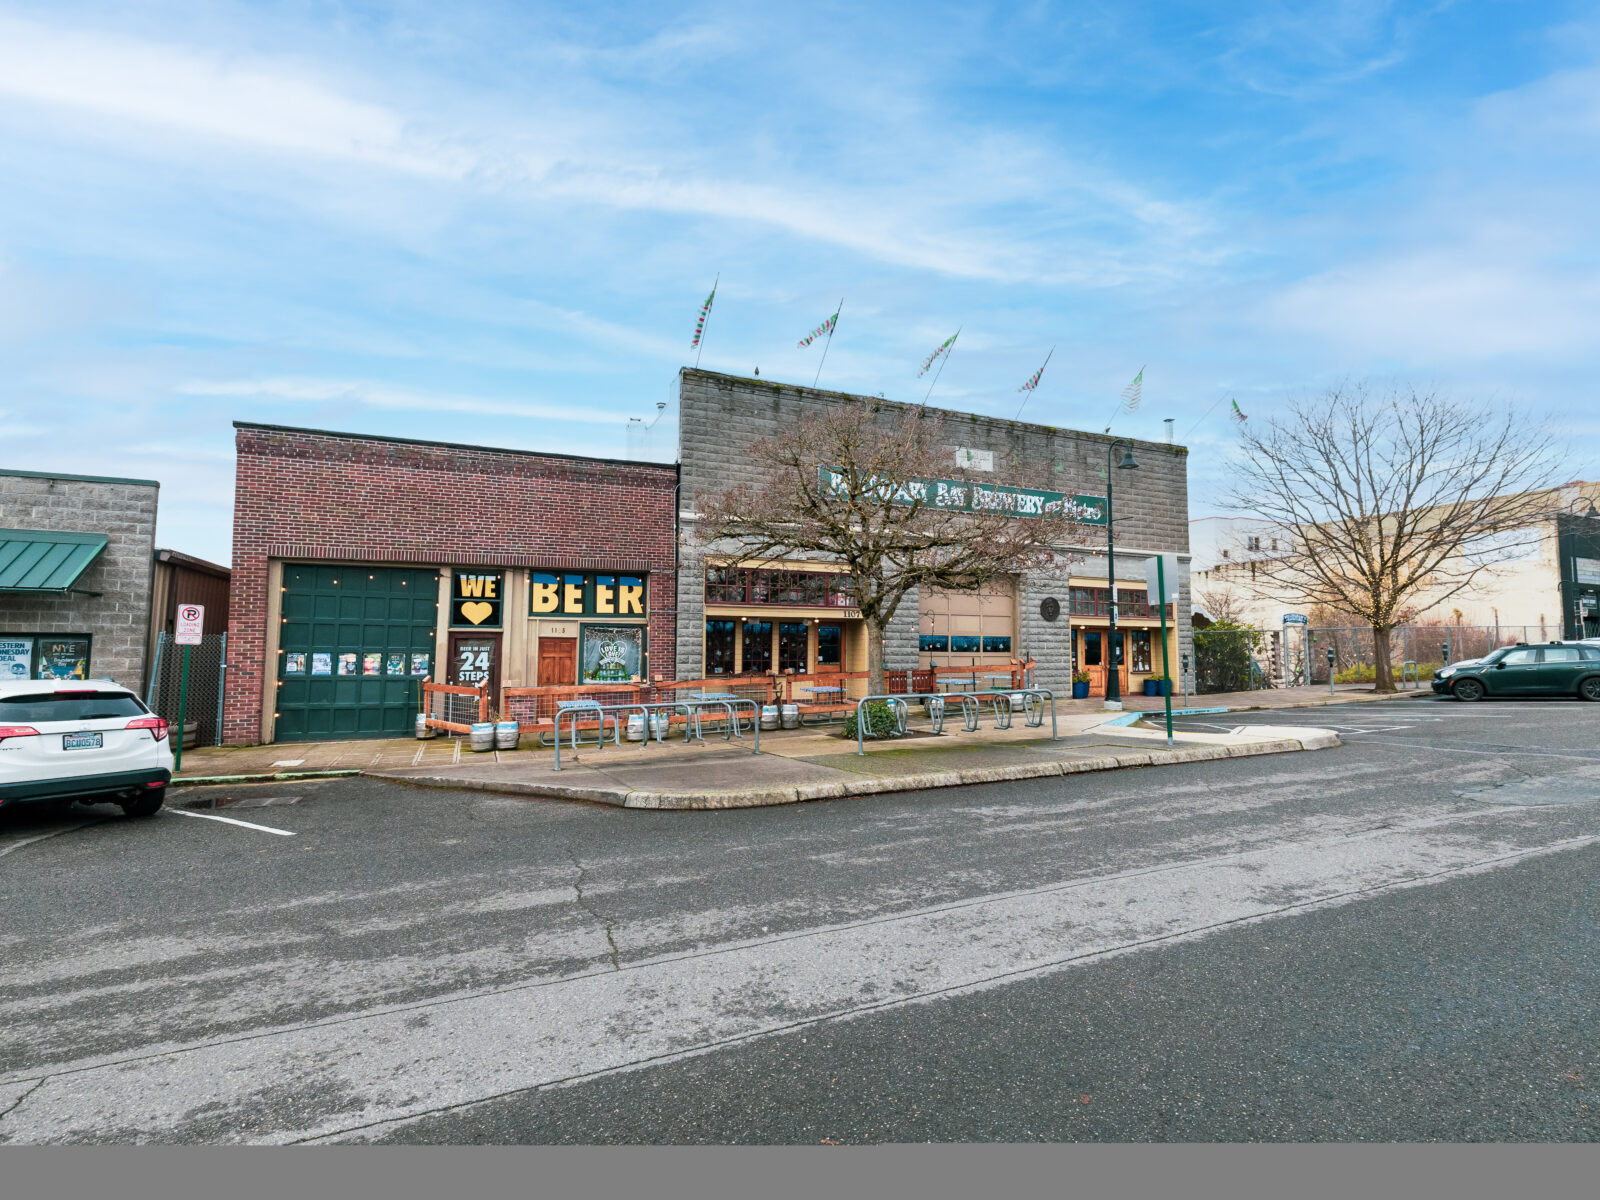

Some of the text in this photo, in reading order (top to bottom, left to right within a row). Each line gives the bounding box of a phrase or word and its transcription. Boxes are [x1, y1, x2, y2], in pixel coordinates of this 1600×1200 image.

[460, 575, 496, 598] WE
[532, 573, 643, 614] BEER
[52, 644, 76, 653] NYE
[460, 651, 490, 671] 24
[459, 671, 490, 681] STEPS
